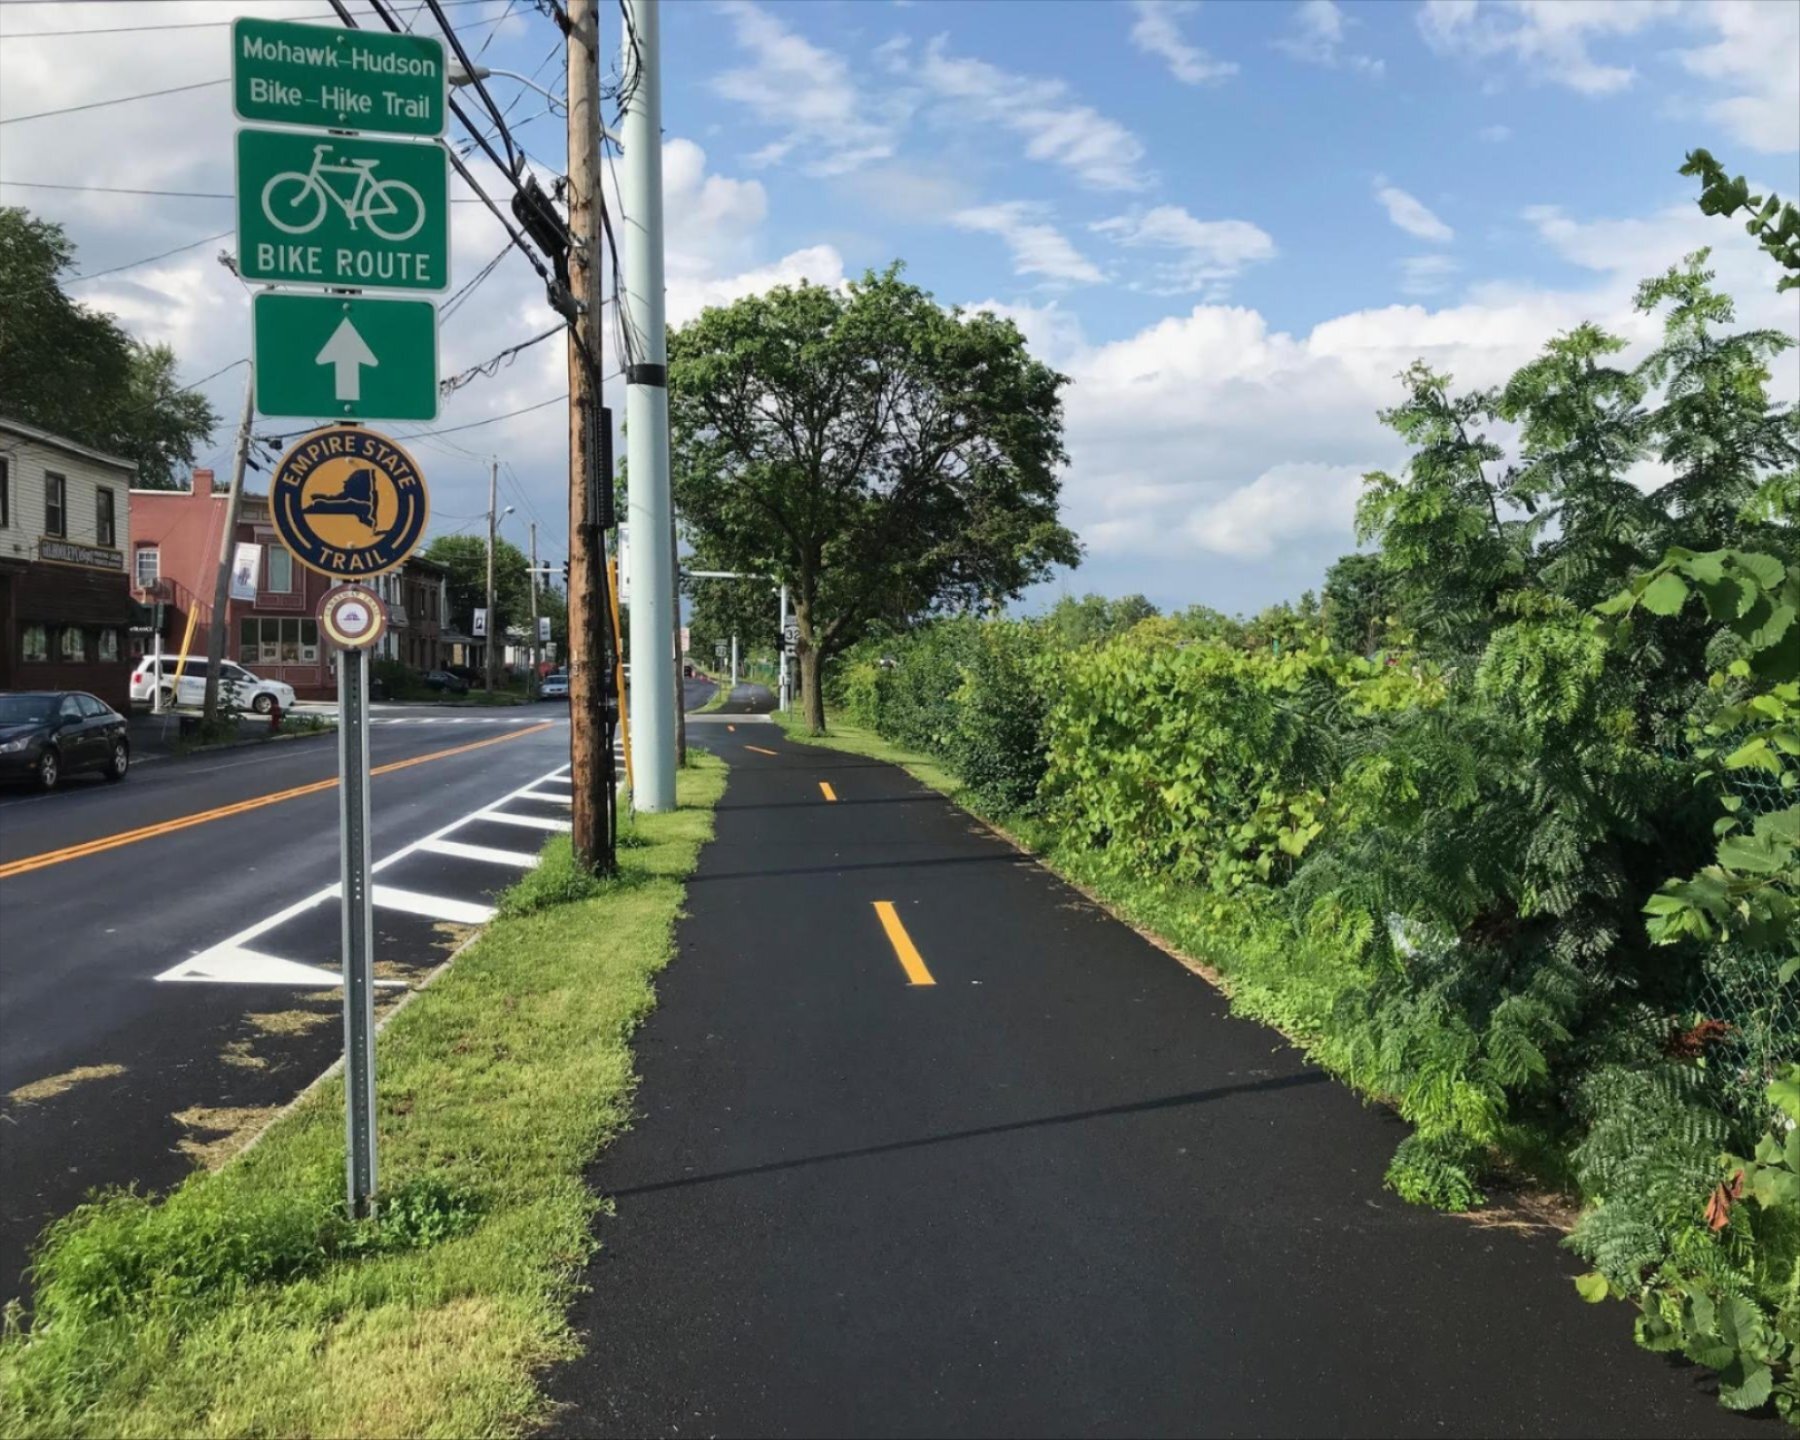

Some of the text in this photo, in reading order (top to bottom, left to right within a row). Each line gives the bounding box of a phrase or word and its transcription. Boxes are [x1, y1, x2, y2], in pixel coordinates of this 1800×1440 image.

[243, 35, 436, 77] Mohawk-Hudson
[382, 91, 430, 119] Trail
[257, 242, 430, 281] BIKE ROUTE
[282, 435, 417, 490] EMPIRE STATE
[319, 547, 388, 570] TRAIL
